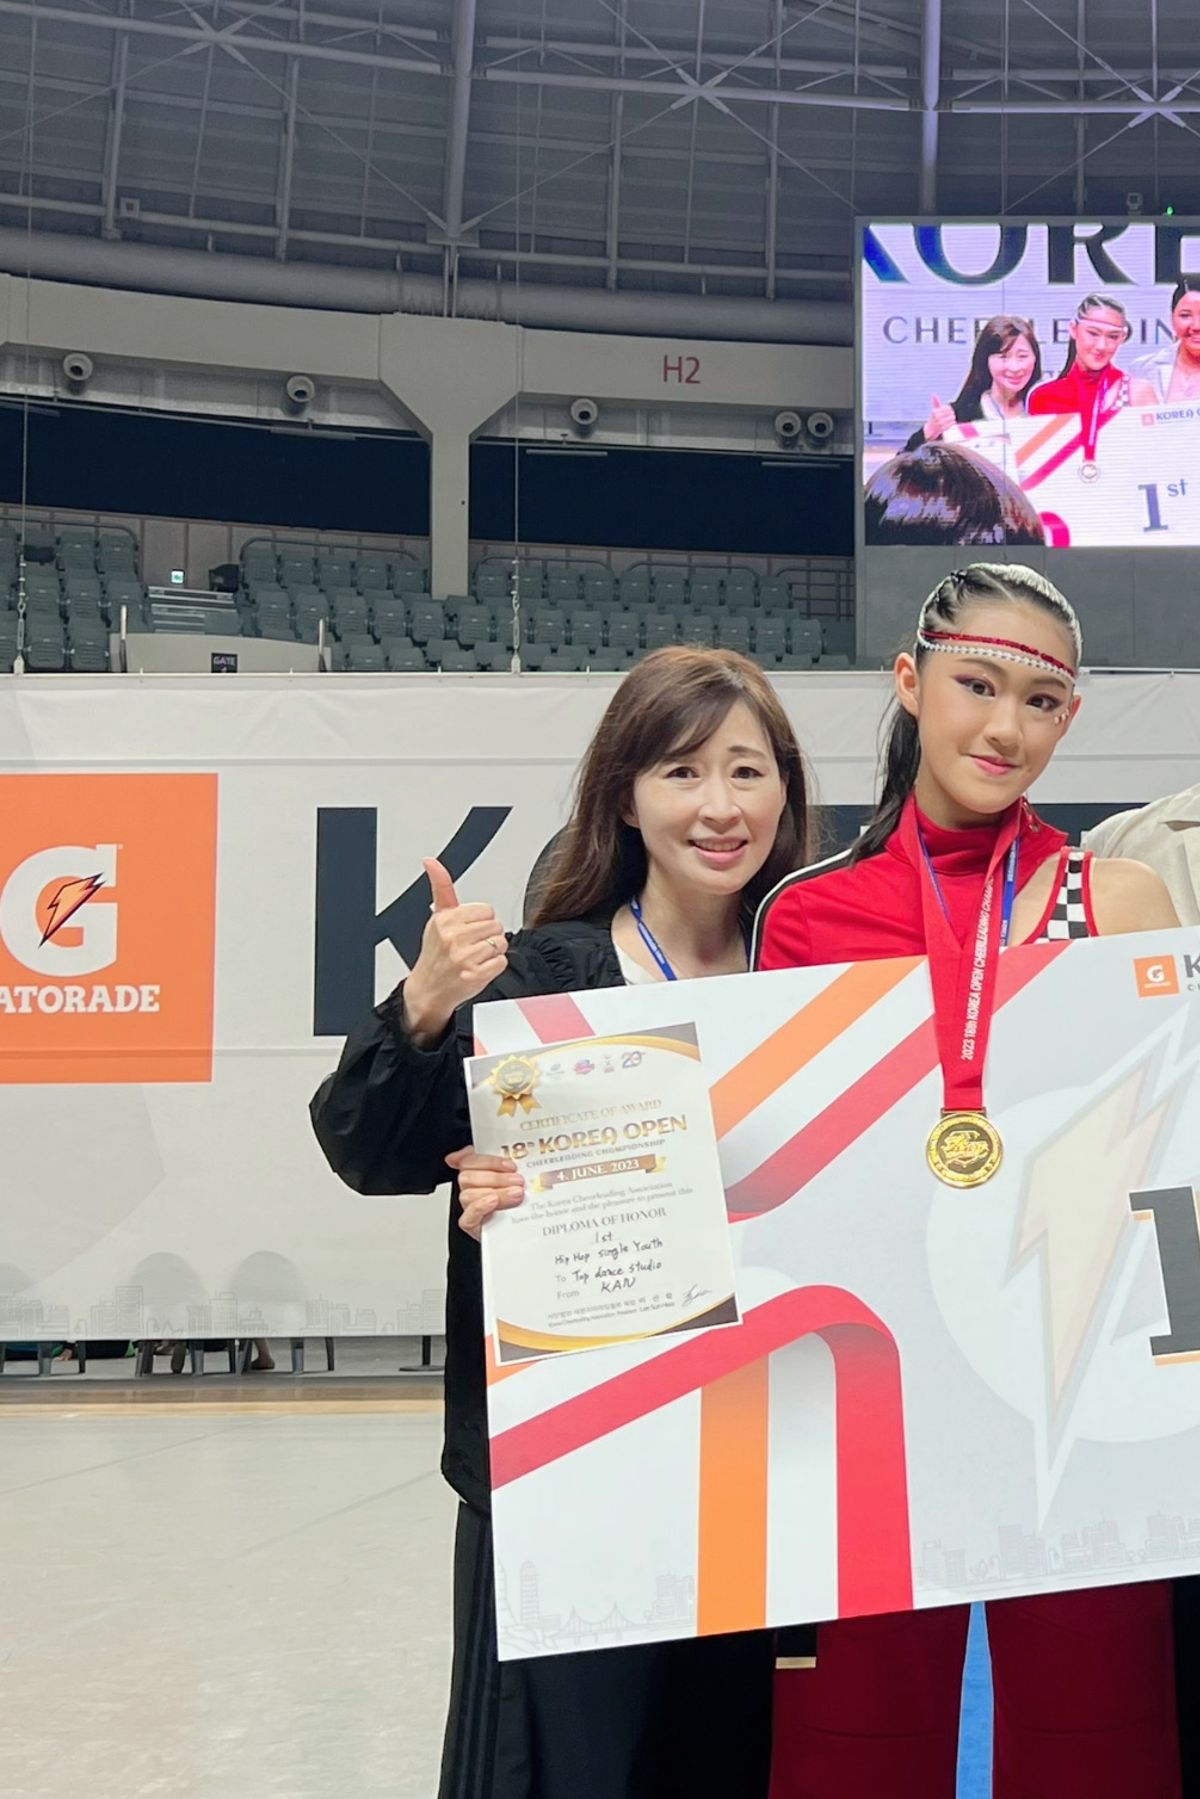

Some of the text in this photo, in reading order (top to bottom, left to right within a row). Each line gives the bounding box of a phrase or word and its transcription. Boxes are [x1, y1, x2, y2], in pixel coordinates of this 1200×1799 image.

[663, 354, 701, 384] H2
[970, 967, 985, 992] OPEN
[966, 992, 981, 1020] KOREA
[961, 1038, 976, 1061] 2023
[538, 1126, 618, 1154] KOREA
[623, 1113, 688, 1140] OPEN
[611, 1159, 640, 1172] 2023
[543, 1207, 668, 1236] DIPLOMA OF HONOR
[633, 1237, 664, 1251] Youth
